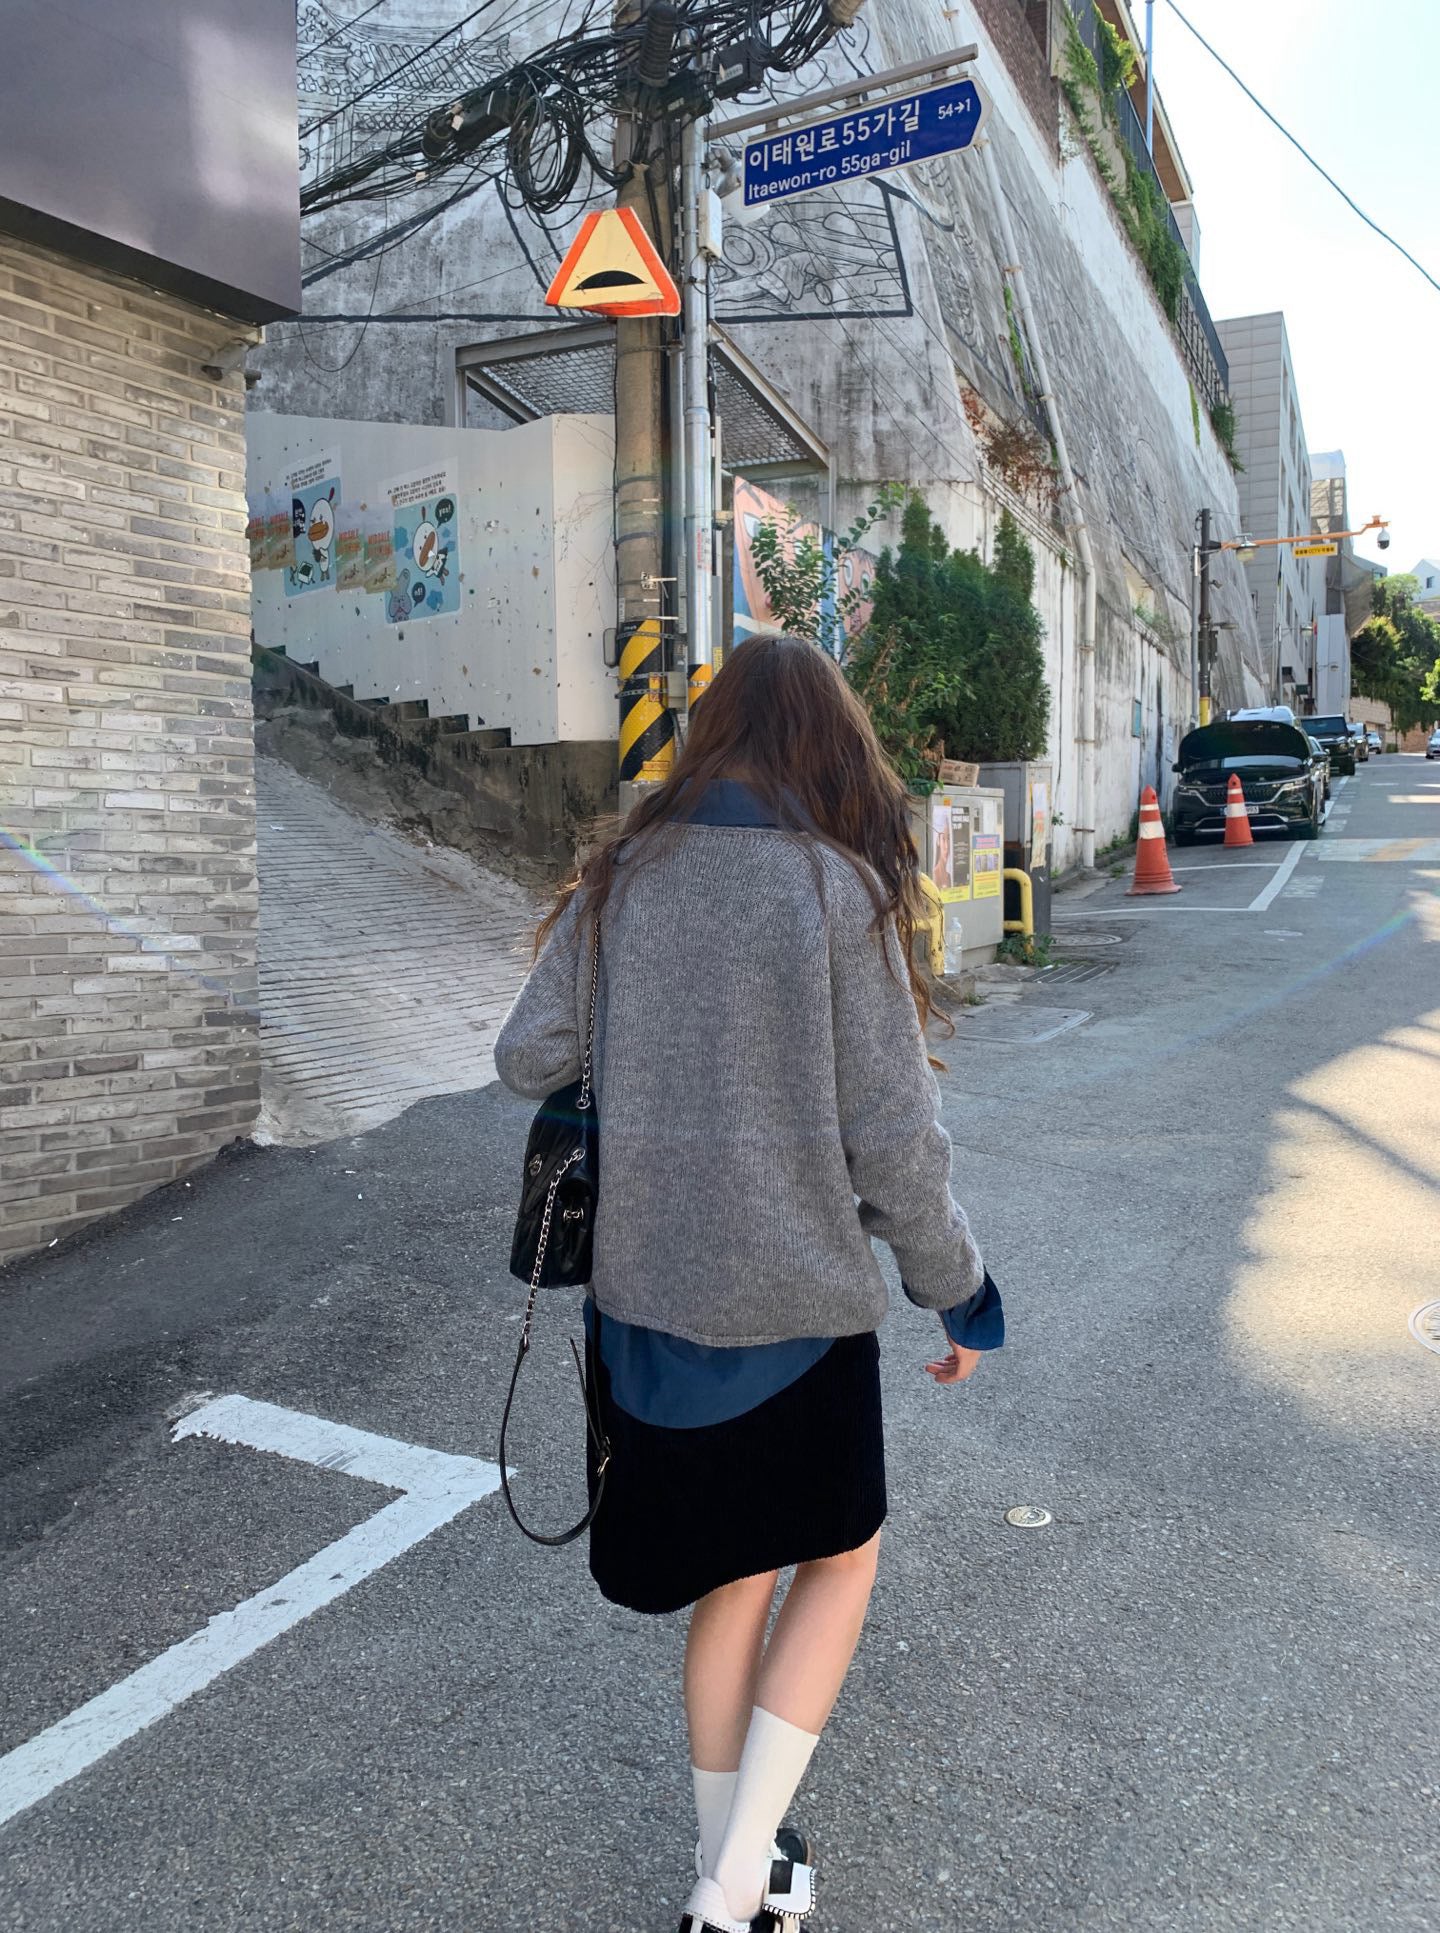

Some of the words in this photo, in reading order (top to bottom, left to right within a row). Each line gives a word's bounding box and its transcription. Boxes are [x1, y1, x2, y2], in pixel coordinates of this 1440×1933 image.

[749, 99, 920, 171] 이태원로55가길
[748, 164, 836, 200] Itaewon-ro
[841, 140, 911, 176] 55ga-gil
